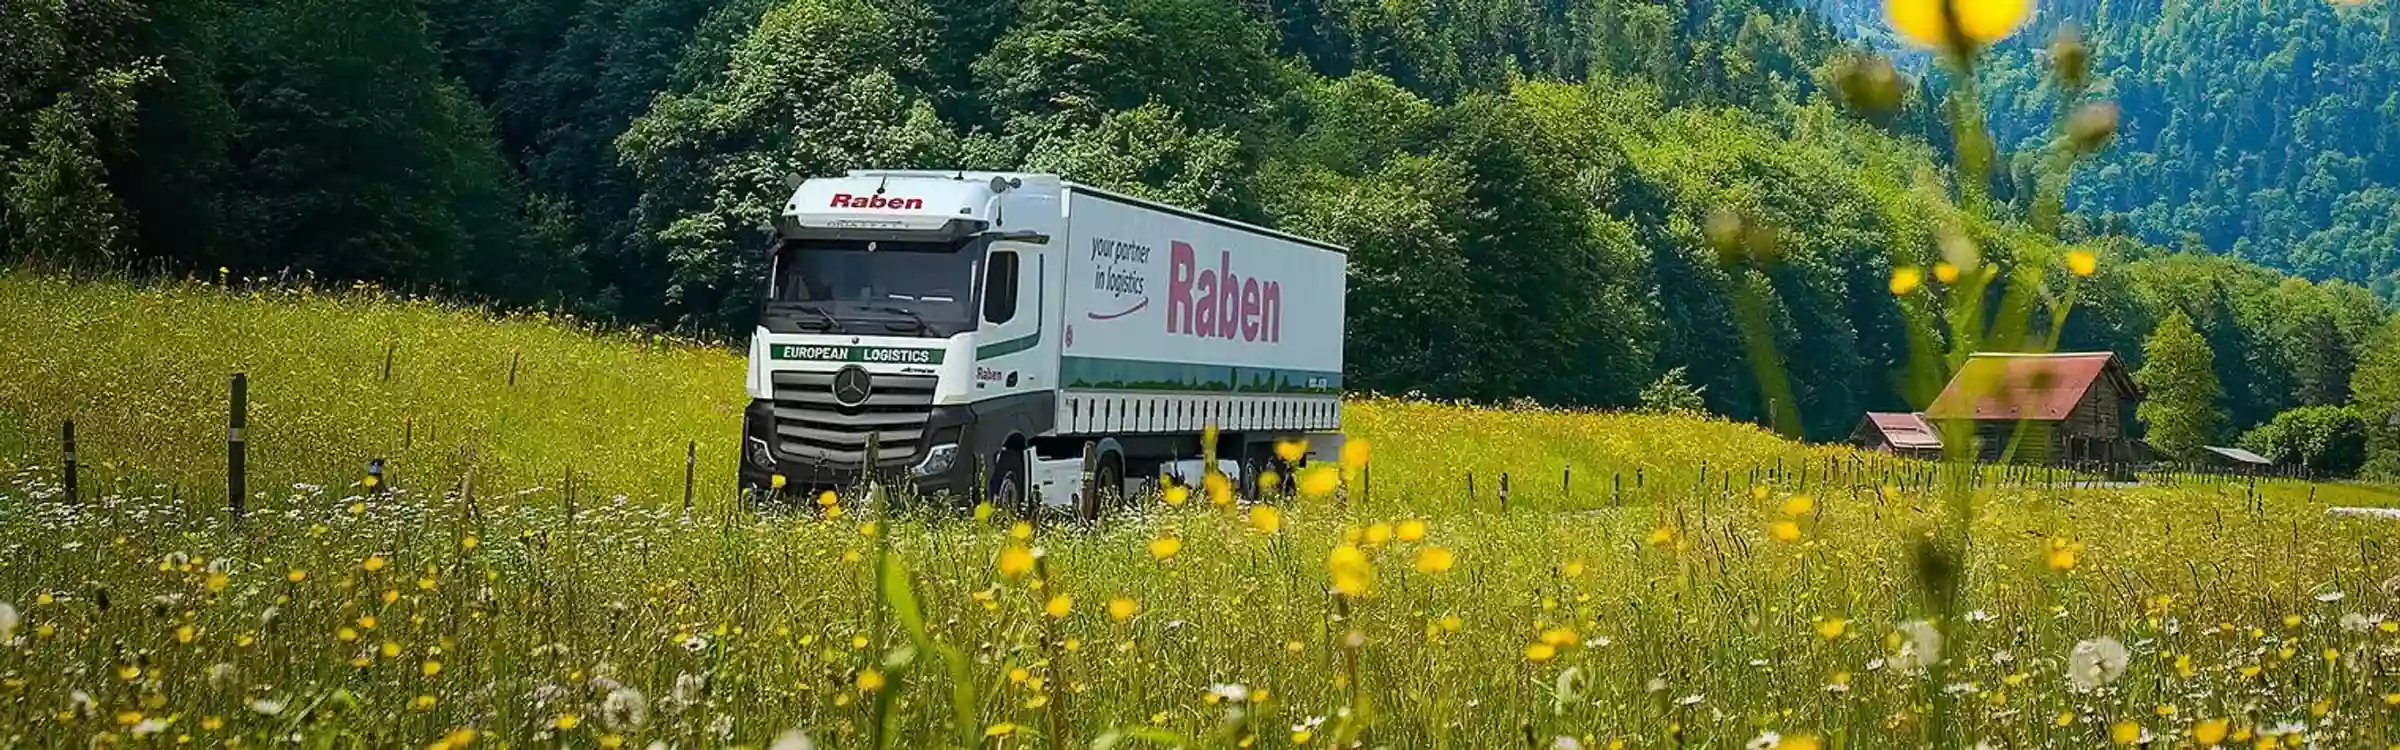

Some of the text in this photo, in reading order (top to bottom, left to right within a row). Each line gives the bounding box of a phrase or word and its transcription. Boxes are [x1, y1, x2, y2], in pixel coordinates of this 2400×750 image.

[830, 193, 923, 209] Raben
[1091, 236, 1150, 264] your partner
[1094, 265, 1144, 297] in logistics
[1167, 240, 1280, 343] Raben
[783, 346, 930, 363] EUROPEAN LOGISTICS
[976, 366, 1002, 381] Raben
